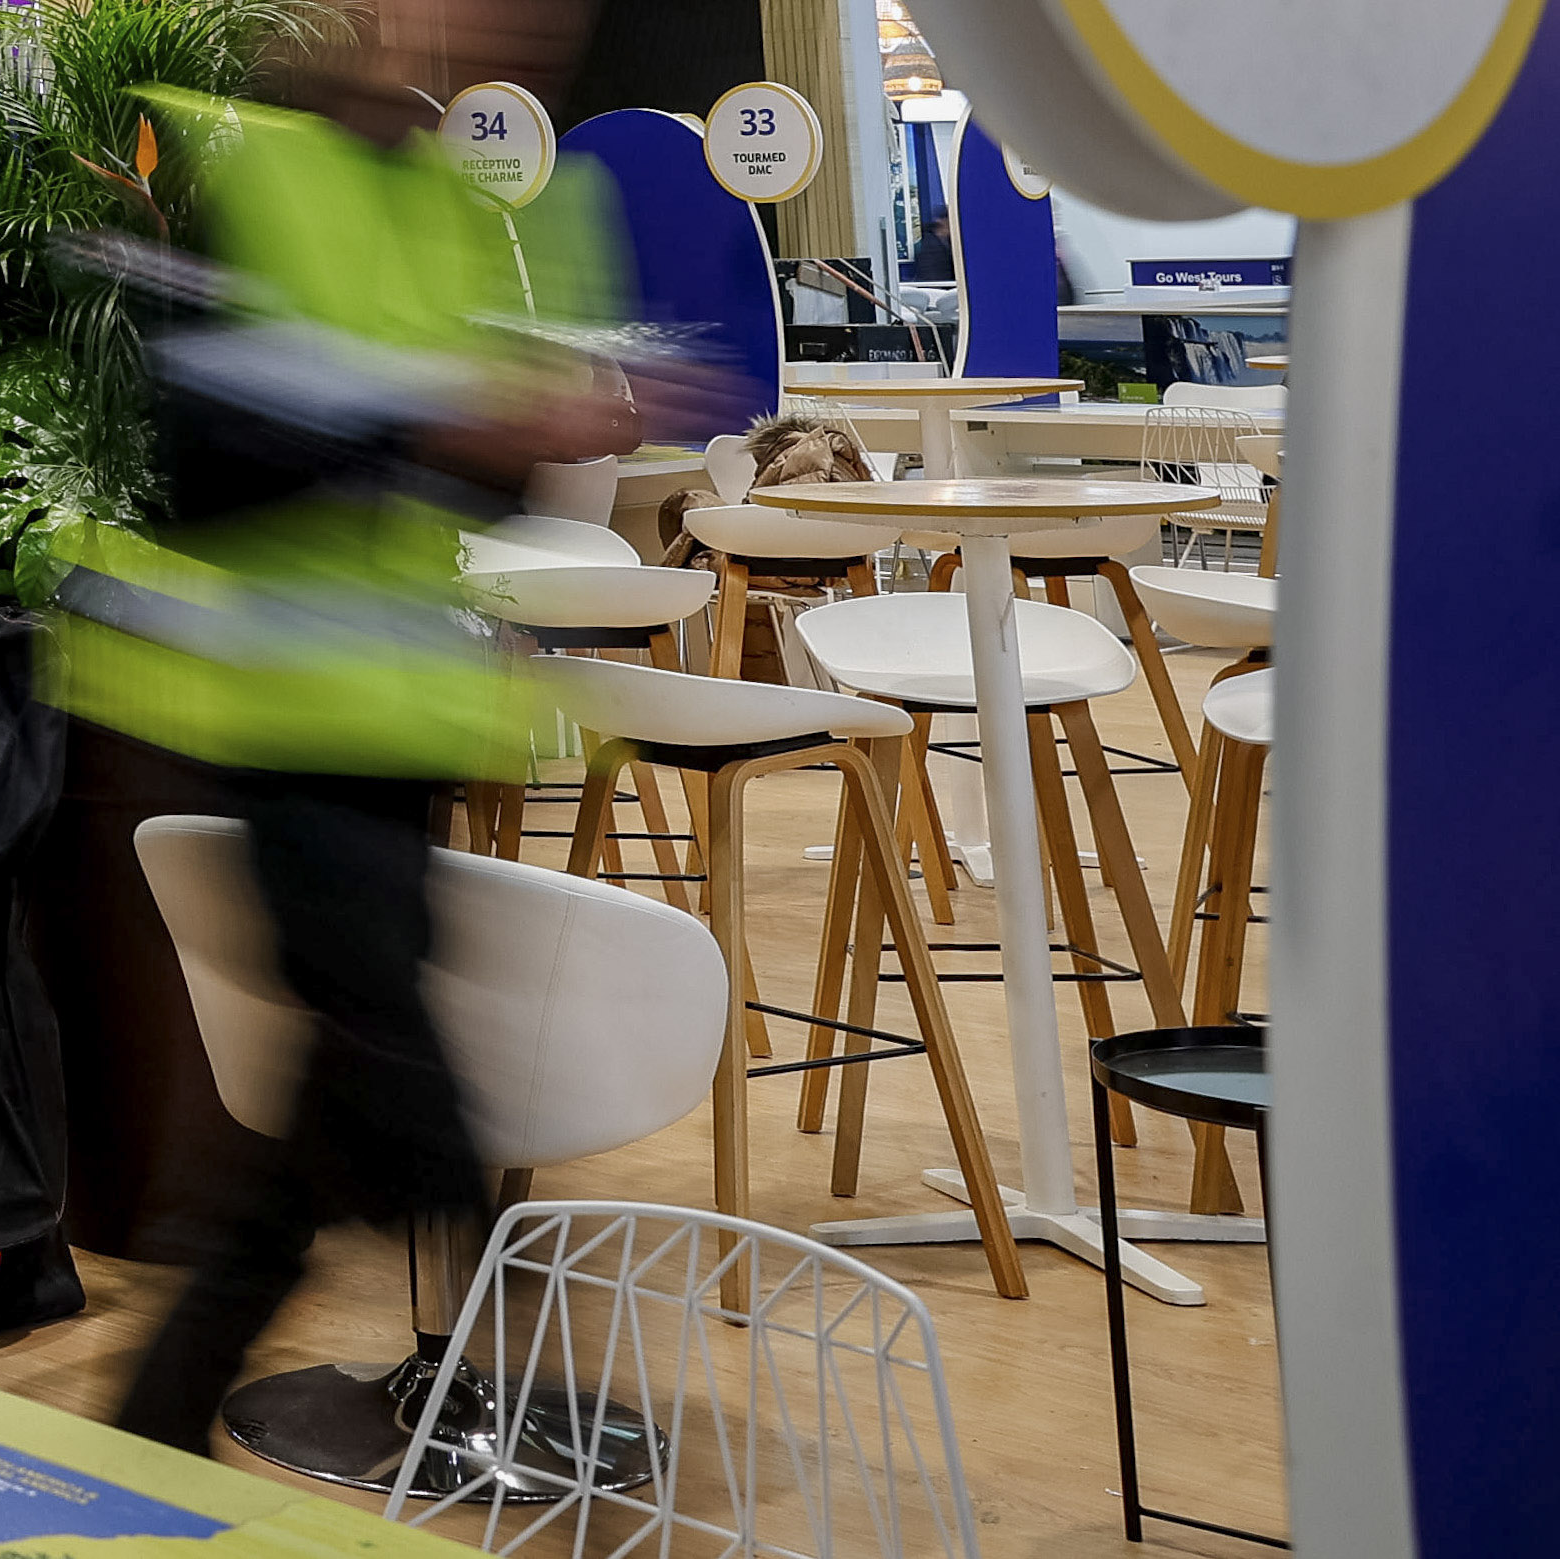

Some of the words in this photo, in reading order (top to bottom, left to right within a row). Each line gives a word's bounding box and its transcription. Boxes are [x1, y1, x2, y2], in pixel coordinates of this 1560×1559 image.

[471, 111, 507, 141] 34
[740, 108, 776, 136] 33
[733, 152, 786, 163] TOURMED
[463, 158, 520, 170] RECEPTIVO
[748, 165, 772, 175] DMC
[478, 172, 523, 183] CHARME
[1155, 272, 1173, 283] Go
[1175, 271, 1205, 283] West
[1206, 271, 1242, 283] Tours
